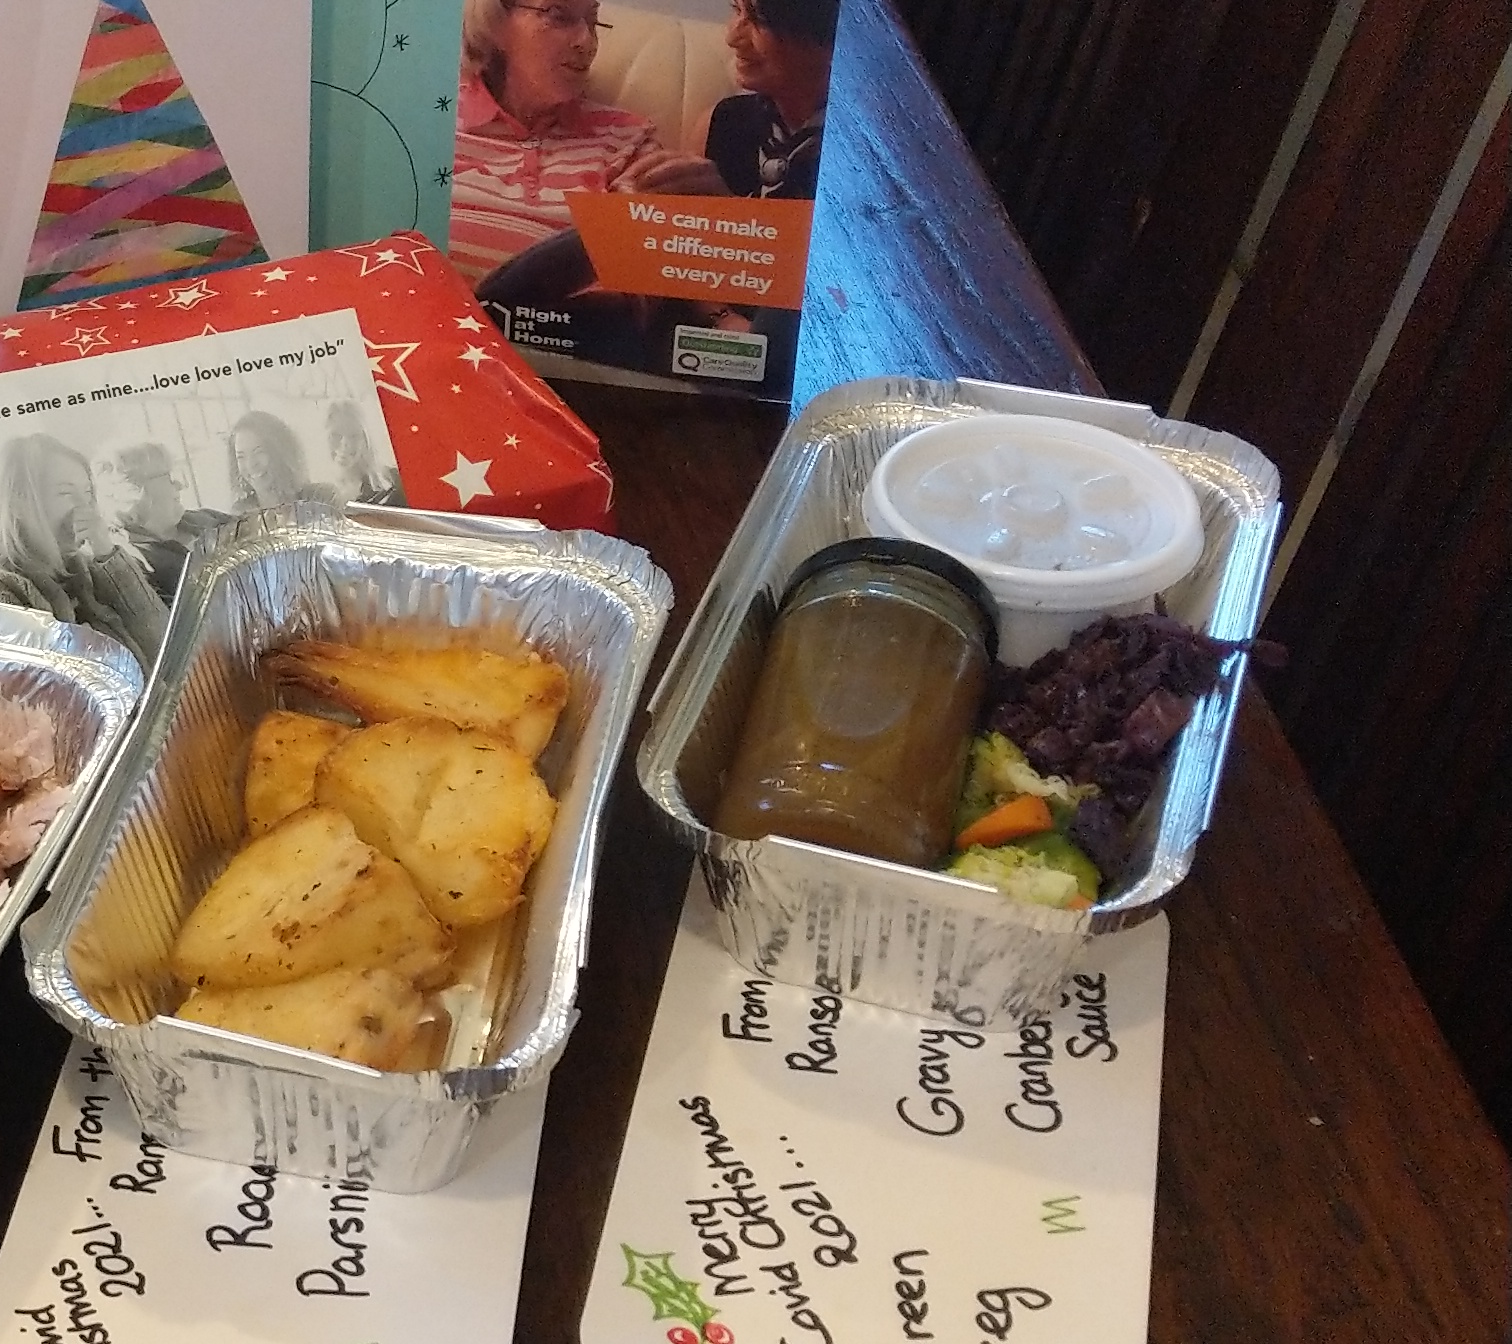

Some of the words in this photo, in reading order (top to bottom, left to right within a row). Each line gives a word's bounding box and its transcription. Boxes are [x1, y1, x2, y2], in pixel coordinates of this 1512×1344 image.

[628, 201, 666, 224] We
[672, 212, 710, 232] can
[714, 217, 778, 240] make
[643, 235, 657, 251] a
[663, 235, 776, 266] difference
[661, 264, 725, 289] every
[729, 271, 773, 295] day
[514, 320, 535, 331] at
[514, 330, 575, 348] Home
[516, 306, 572, 324] Right
[17, 397, 61, 415] same
[67, 392, 86, 406] as
[195, 365, 232, 383] love
[236, 357, 274, 374] love
[279, 350, 304, 367] my
[722, 980, 772, 1043] From
[1064, 972, 1118, 1063] Sauce
[896, 1028, 985, 1136] Gravy
[52, 1094, 109, 1163] From
[679, 1095, 786, 1249] Christmas
[685, 1197, 754, 1297] Merry
